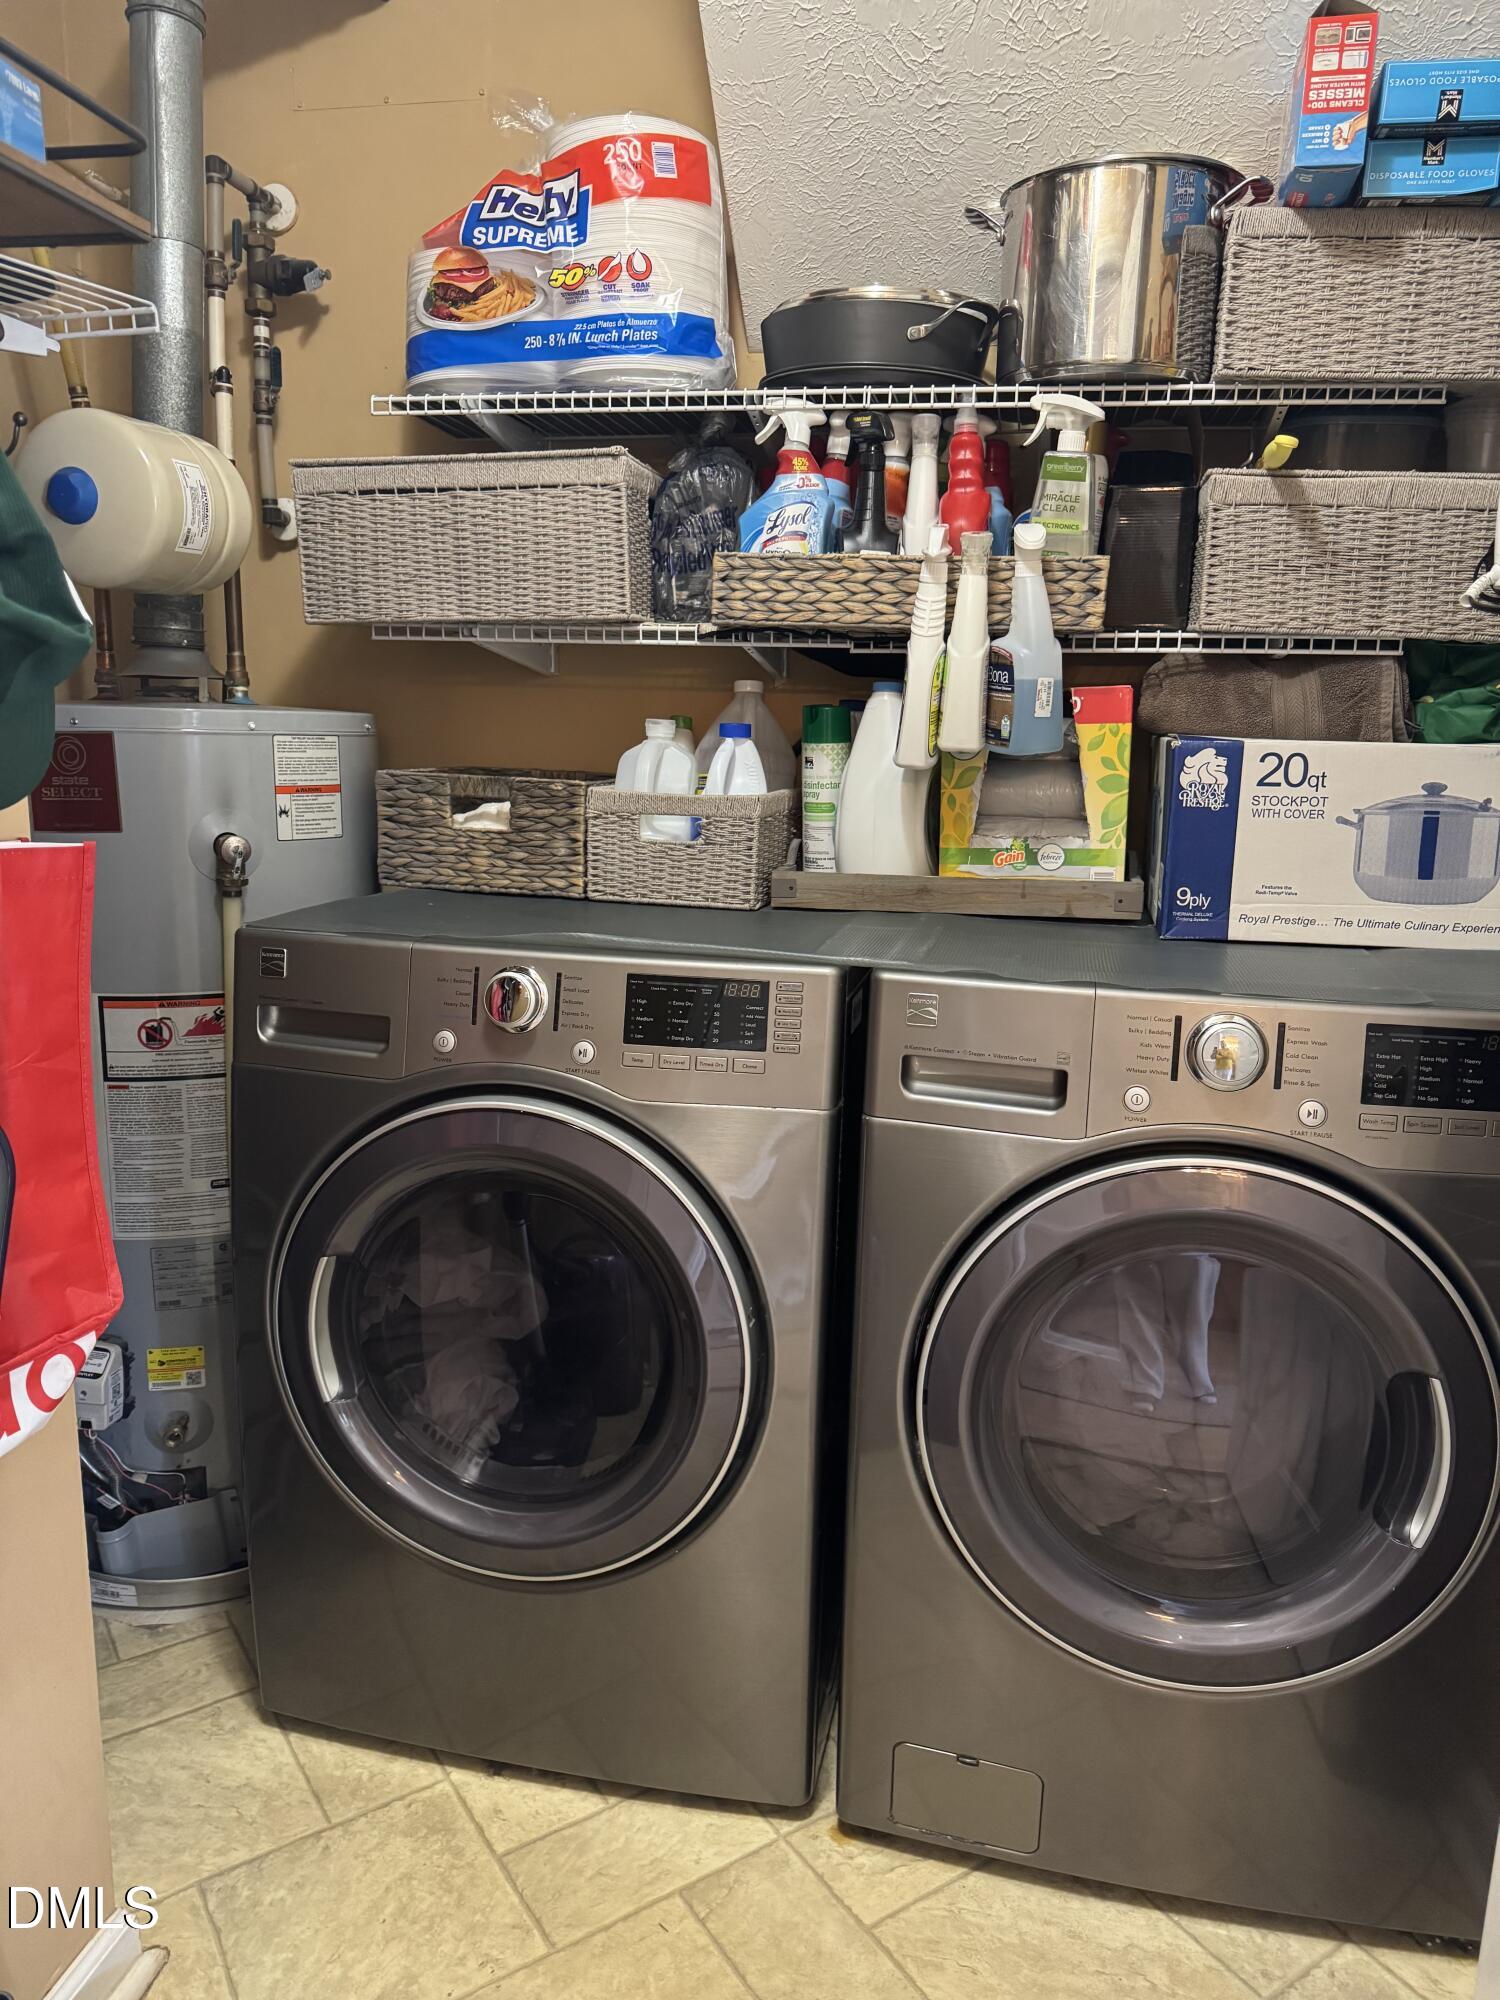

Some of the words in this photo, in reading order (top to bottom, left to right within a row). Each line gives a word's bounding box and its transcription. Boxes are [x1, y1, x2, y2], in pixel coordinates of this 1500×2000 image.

[1389, 77, 1425, 87] GLOVES
[1430, 76, 1457, 85] FOOD
[1309, 88, 1366, 100] MESSES
[1329, 99, 1365, 108] CLEANS
[603, 141, 642, 165] 250
[1369, 171, 1425, 180] DISPOSABLE
[1428, 170, 1455, 178] FOOD
[1458, 168, 1496, 177] GLOVES
[472, 222, 578, 248] SUPREME
[549, 262, 597, 290] 50%
[598, 320, 617, 329] Platos
[626, 318, 658, 326] Almuerzo
[585, 329, 618, 342] Lunch
[621, 328, 658, 342] Plates
[792, 457, 809, 467] 45%
[1047, 463, 1084, 472] greenberry
[1042, 493, 1081, 503] MIRACLE
[1042, 504, 1076, 513] CLEAR
[766, 506, 812, 535] Lysol
[1256, 752, 1328, 792] 20qt
[52, 776, 88, 785] state
[40, 786, 104, 798] SELECT
[1251, 796, 1328, 808] STOCKPOT
[1252, 808, 1281, 818] WITH
[1284, 809, 1325, 820] COVER
[993, 850, 1025, 868] Gain
[1176, 886, 1211, 910] 9ply
[1238, 914, 1270, 925] Royal
[1333, 918, 1353, 928] The
[1356, 918, 1400, 930] Ultimate
[1404, 920, 1450, 934] Culinary
[166, 1000, 201, 1008] WARNING
[909, 996, 937, 1005] Kenmore
[562, 1010, 579, 1018] Express
[1127, 1014, 1149, 1022] Normal
[1128, 1028, 1145, 1036] Bulky
[1149, 1029, 1172, 1037] Bedding
[1286, 1039, 1310, 1048] Express
[934, 1046, 954, 1054] Connect
[993, 1051, 1018, 1060] Vibration
[1136, 1054, 1154, 1062] Heavy
[664, 1058, 672, 1066] Dry
[1284, 1066, 1312, 1074] Delicates
[1407, 1120, 1420, 1128] Spin
